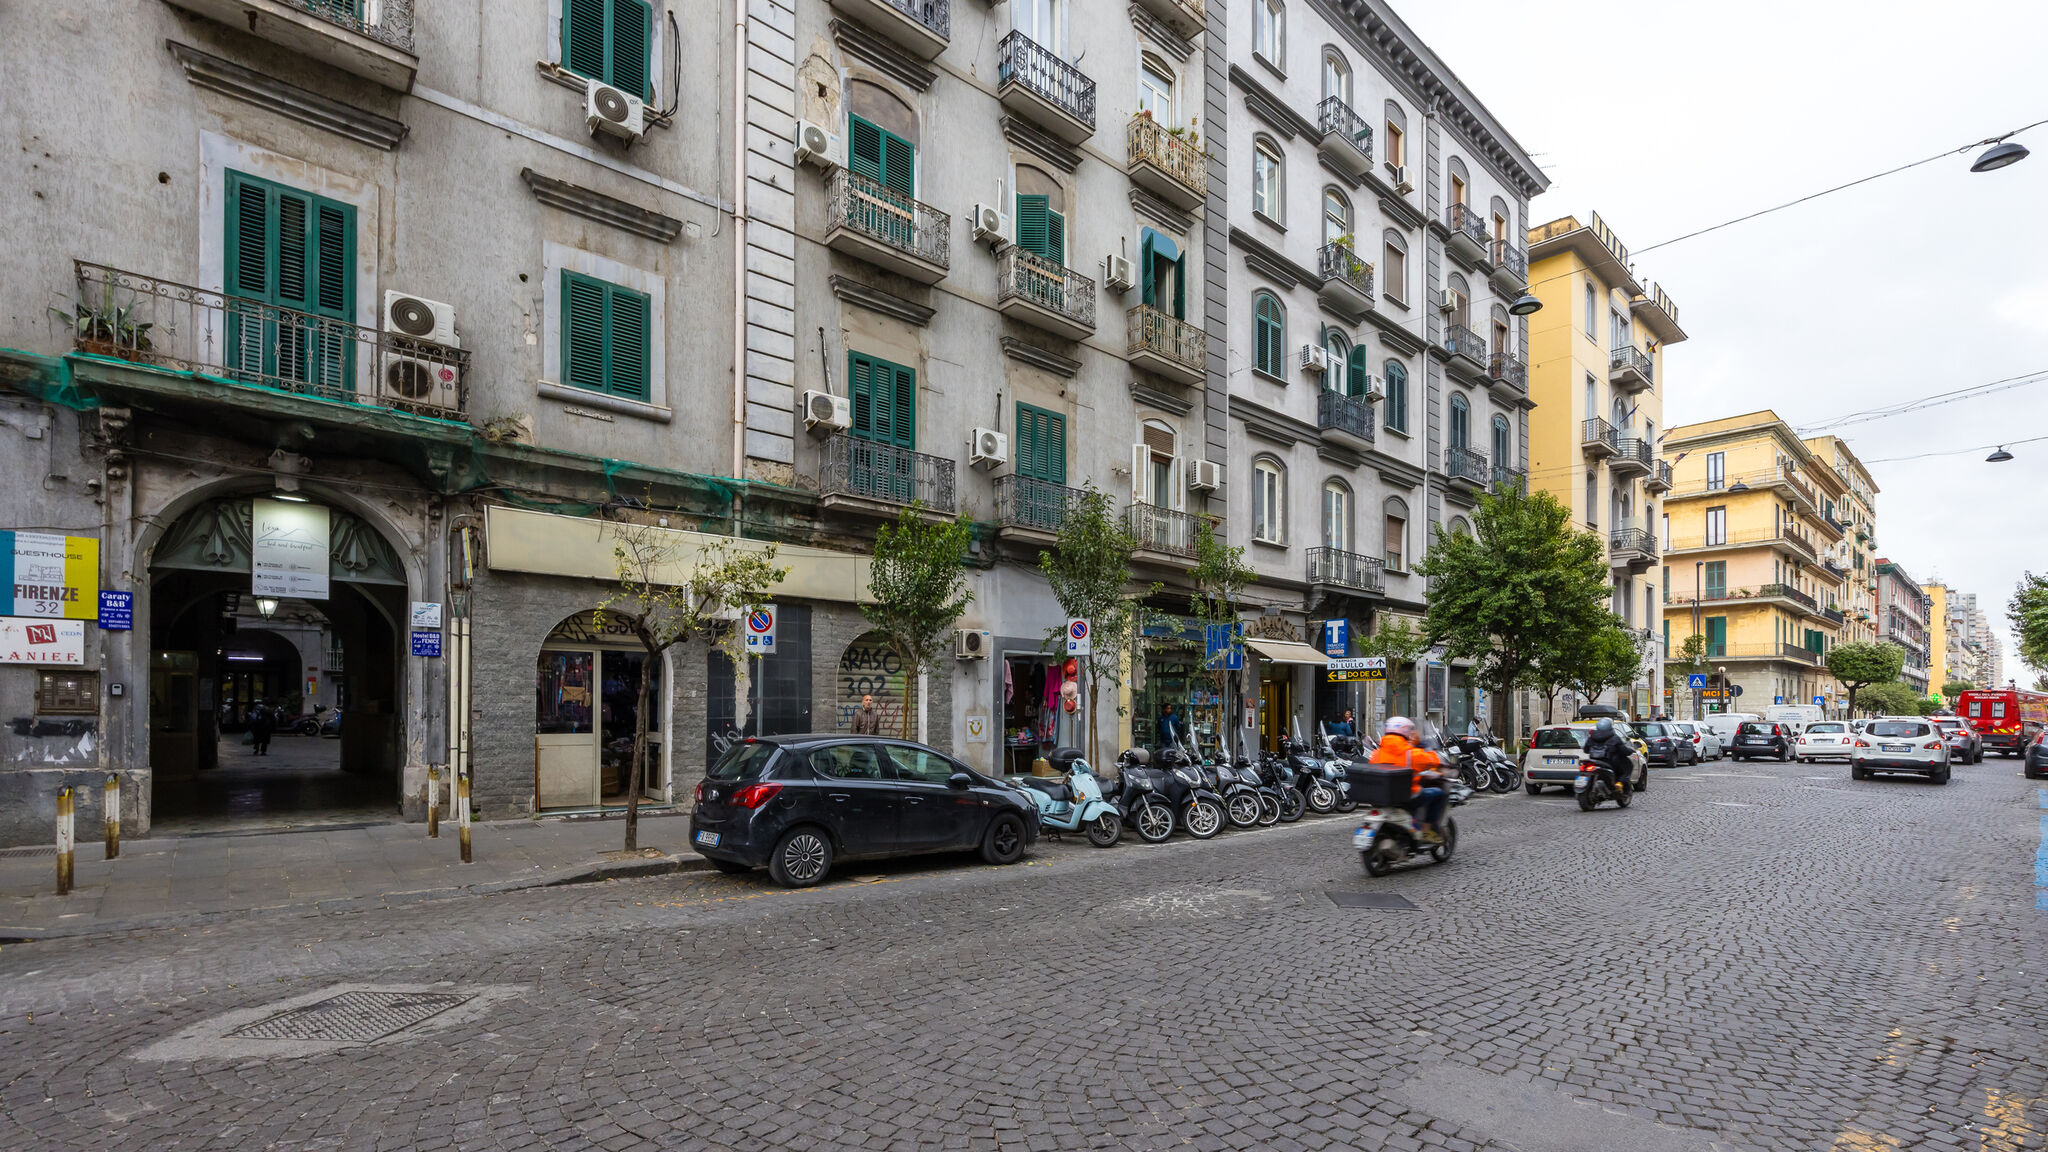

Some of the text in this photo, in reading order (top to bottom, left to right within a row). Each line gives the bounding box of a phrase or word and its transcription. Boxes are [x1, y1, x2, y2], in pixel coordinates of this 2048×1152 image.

[10, 549, 83, 560] GUESTHOUSE
[14, 584, 79, 602] FIRENZE
[101, 592, 131, 602] Caraty
[34, 601, 58, 614] 32
[106, 600, 126, 608] B&B
[9, 651, 76, 661] ANIEF
[844, 675, 890, 698] 302
